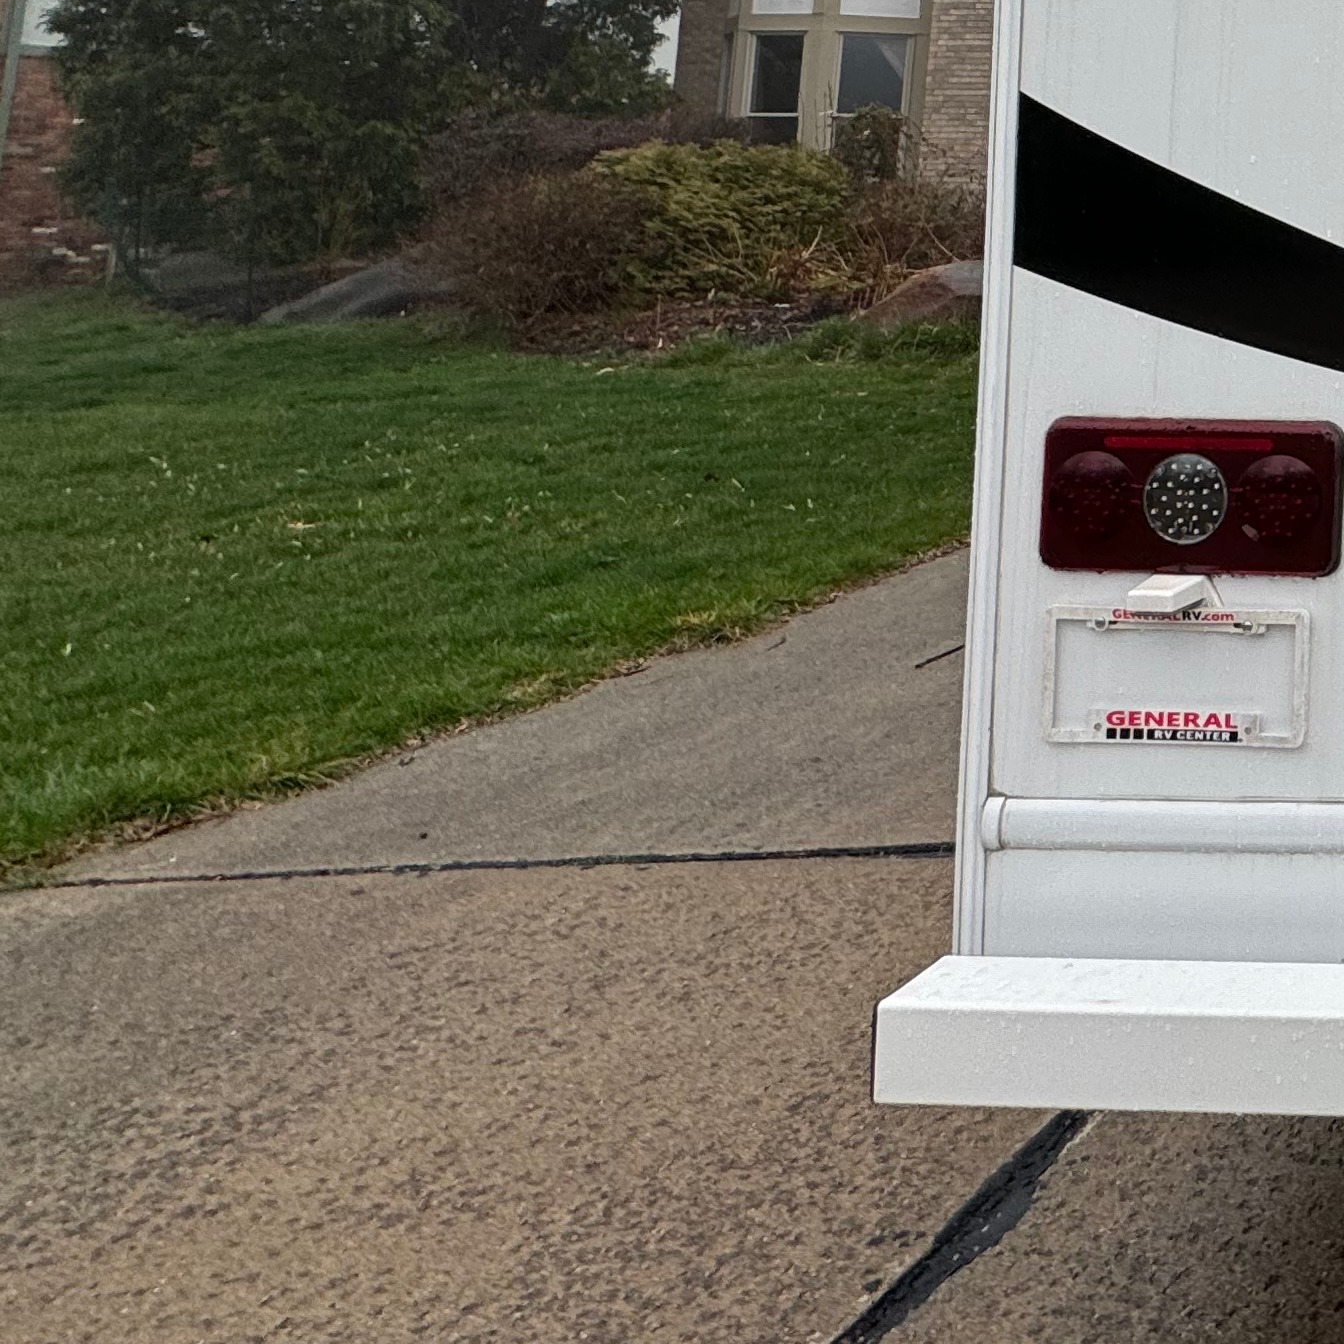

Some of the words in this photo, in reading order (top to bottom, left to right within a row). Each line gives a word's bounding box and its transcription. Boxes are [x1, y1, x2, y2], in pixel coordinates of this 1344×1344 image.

[1105, 710, 1239, 729] GENERAL
[1153, 729, 1173, 740] RV
[1176, 730, 1231, 741] CENTER
